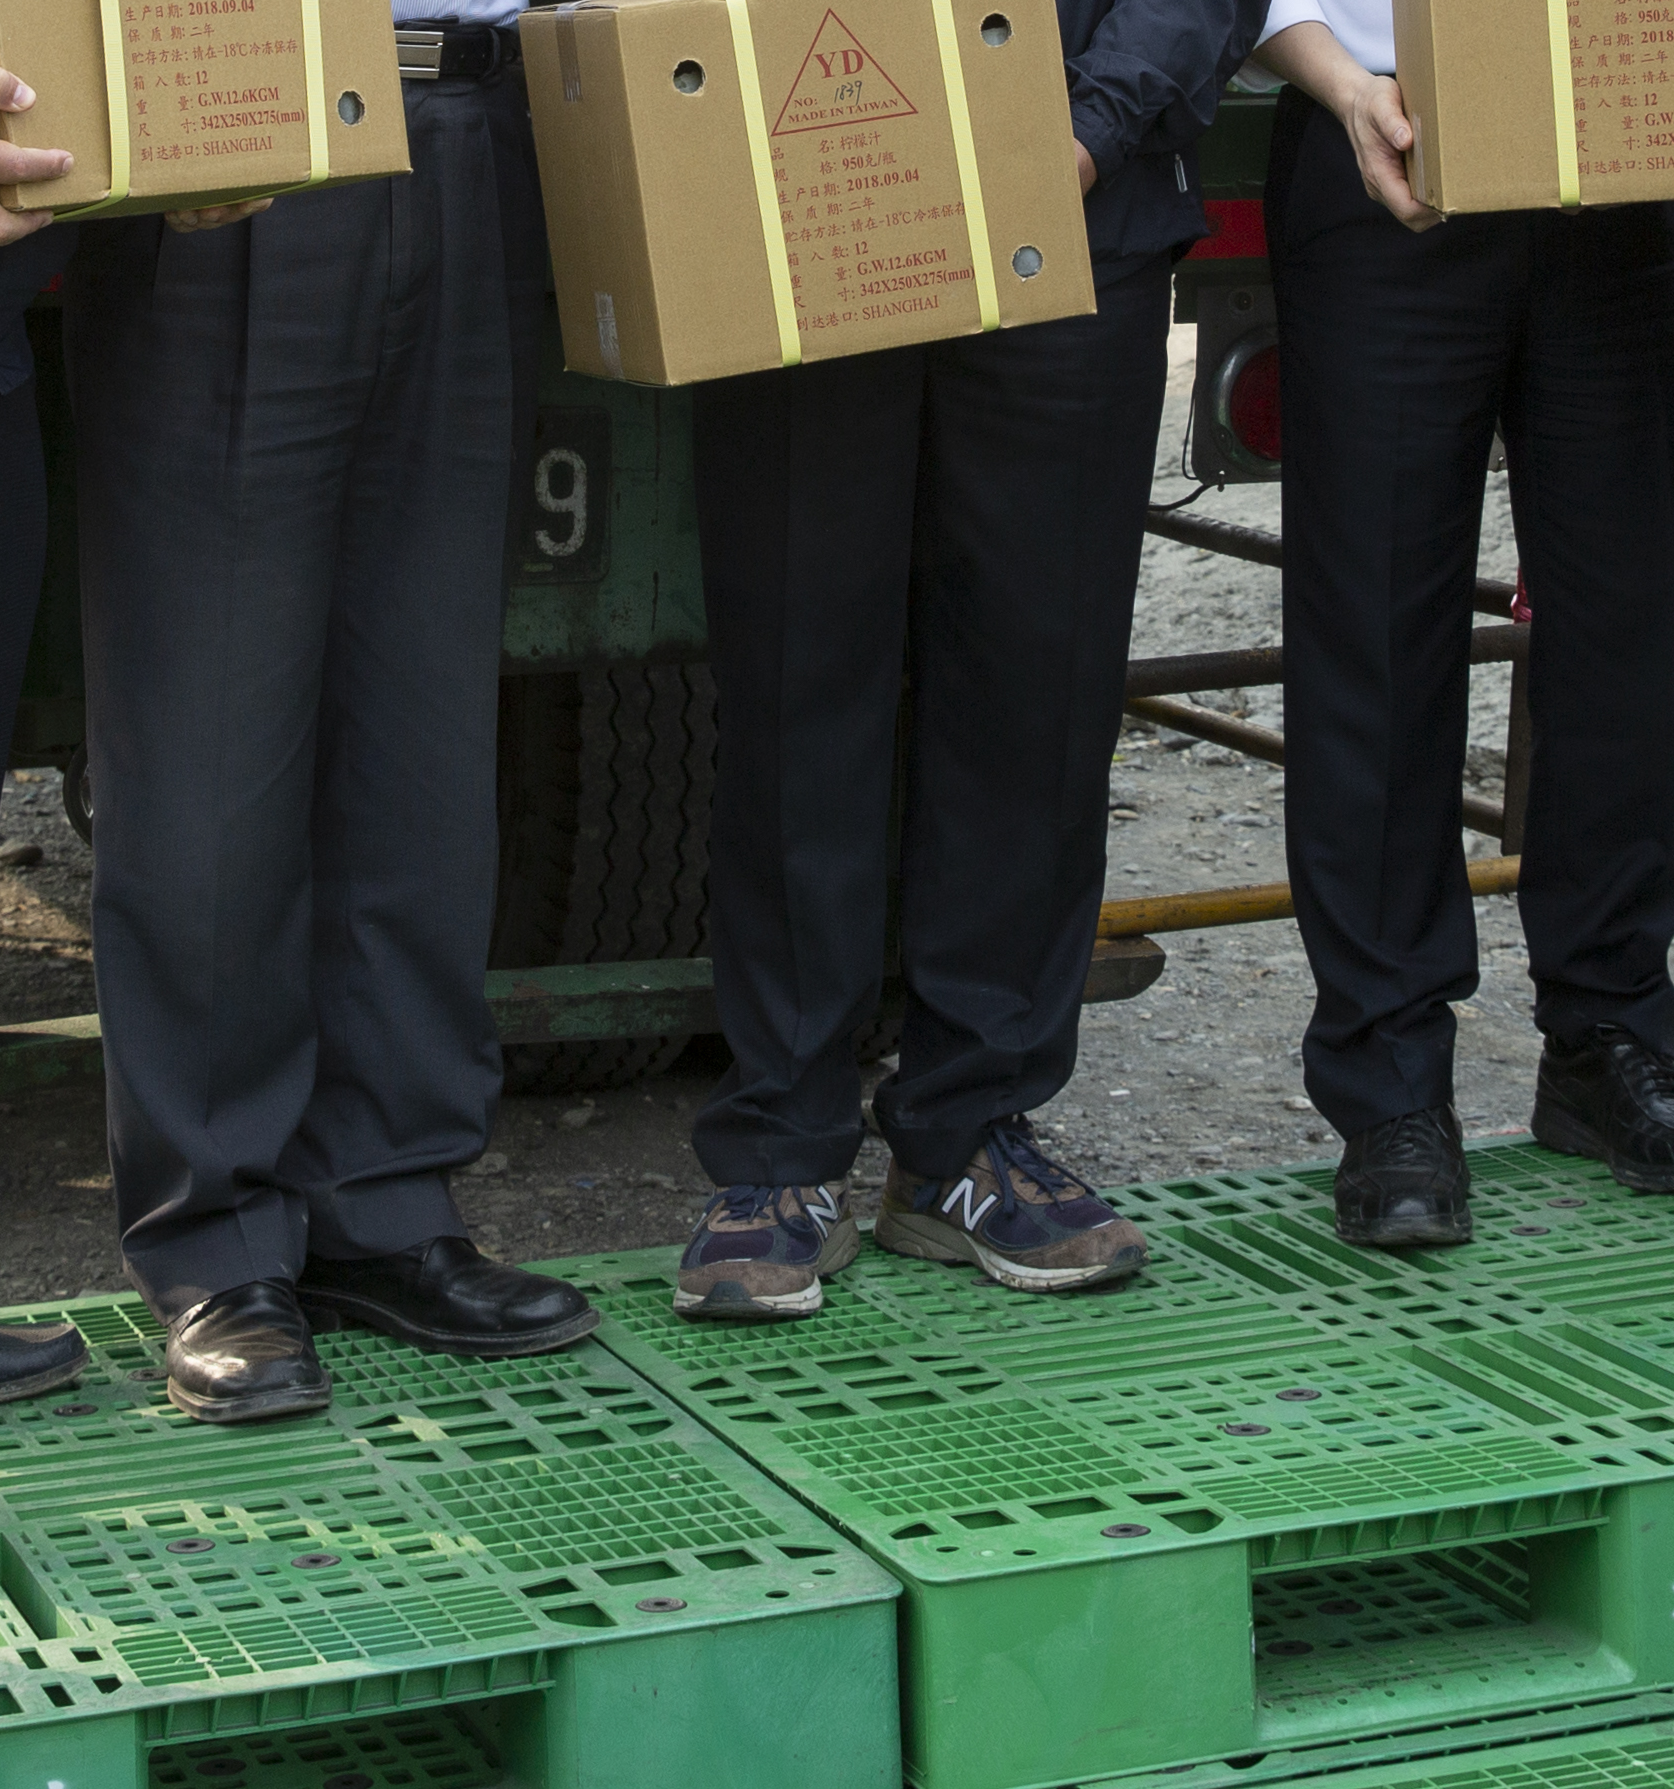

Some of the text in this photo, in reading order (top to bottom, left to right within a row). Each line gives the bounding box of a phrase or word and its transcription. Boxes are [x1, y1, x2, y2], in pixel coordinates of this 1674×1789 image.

[190, 22, 215, 38] 二年
[815, 49, 864, 79] YD
[1640, 49, 1669, 64] 二年
[195, 69, 209, 86] 12
[197, 85, 280, 107] G.W.12.6KGM
[834, 80, 862, 105] 1839
[1643, 92, 1658, 107] 12
[788, 98, 898, 123] MADE IN TAIWAN
[202, 135, 274, 158] SHANGHAI
[847, 168, 921, 193] 2018.09.04
[848, 196, 876, 212] 二年
[854, 240, 869, 256] 12
[856, 247, 948, 275] G.W.12.6KGM
[861, 294, 940, 322] SHANGHAI
[534, 447, 587, 557] 9
[941, 1177, 999, 1232] N
